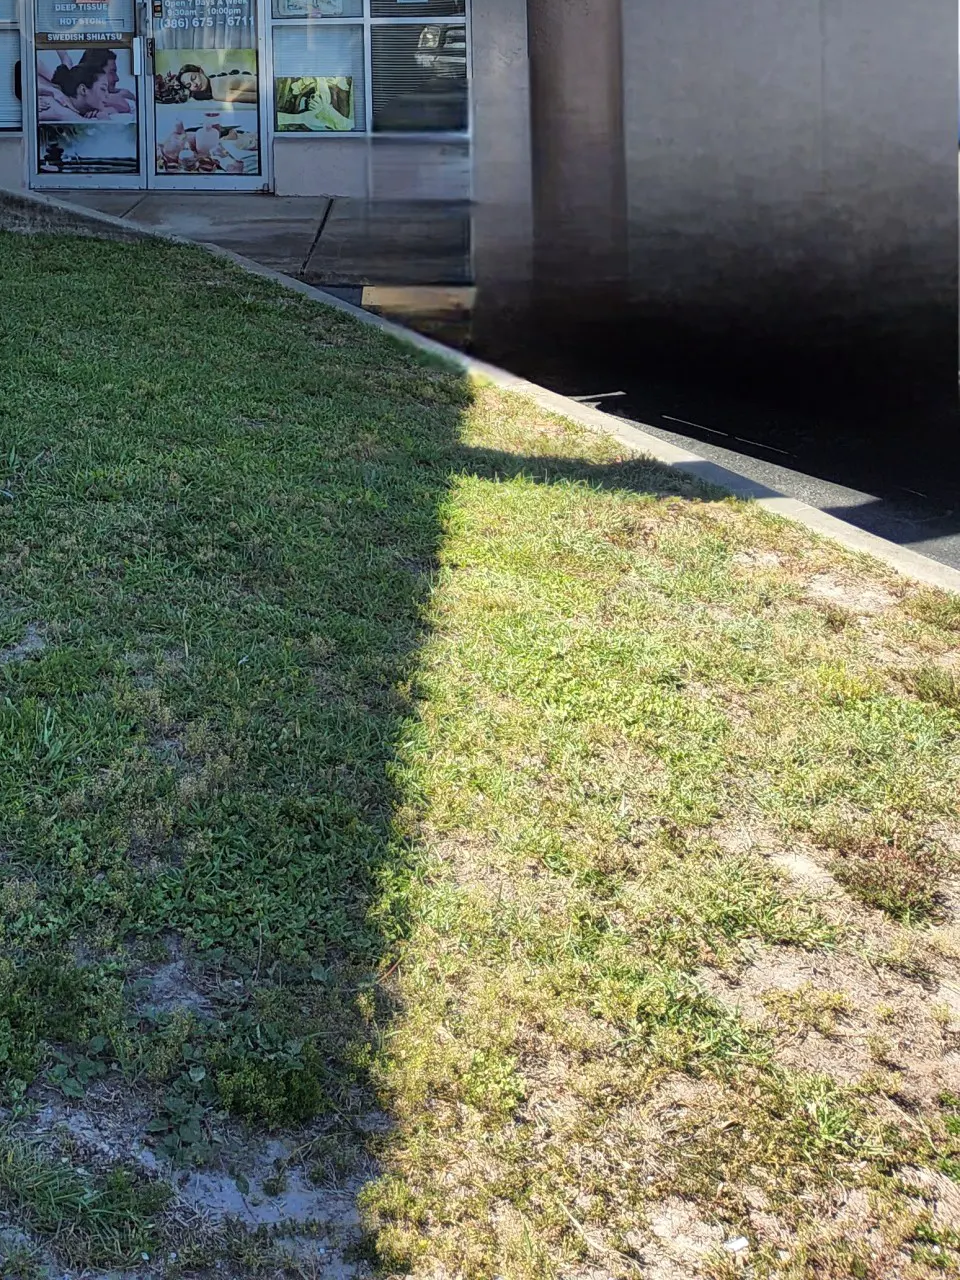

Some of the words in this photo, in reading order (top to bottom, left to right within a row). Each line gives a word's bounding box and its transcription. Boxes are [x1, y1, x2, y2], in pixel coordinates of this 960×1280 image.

[55, 4, 77, 12] DEEP
[78, 3, 108, 11] TISSUE
[164, 0, 186, 8] Open
[195, 0, 215, 7] Days
[59, 17, 77, 25] HOT
[160, 18, 189, 30] (386)
[192, 17, 214, 27] 675
[227, 16, 254, 27] 6711
[47, 33, 85, 41] SWEDISH
[86, 32, 123, 41] SHIATSU
